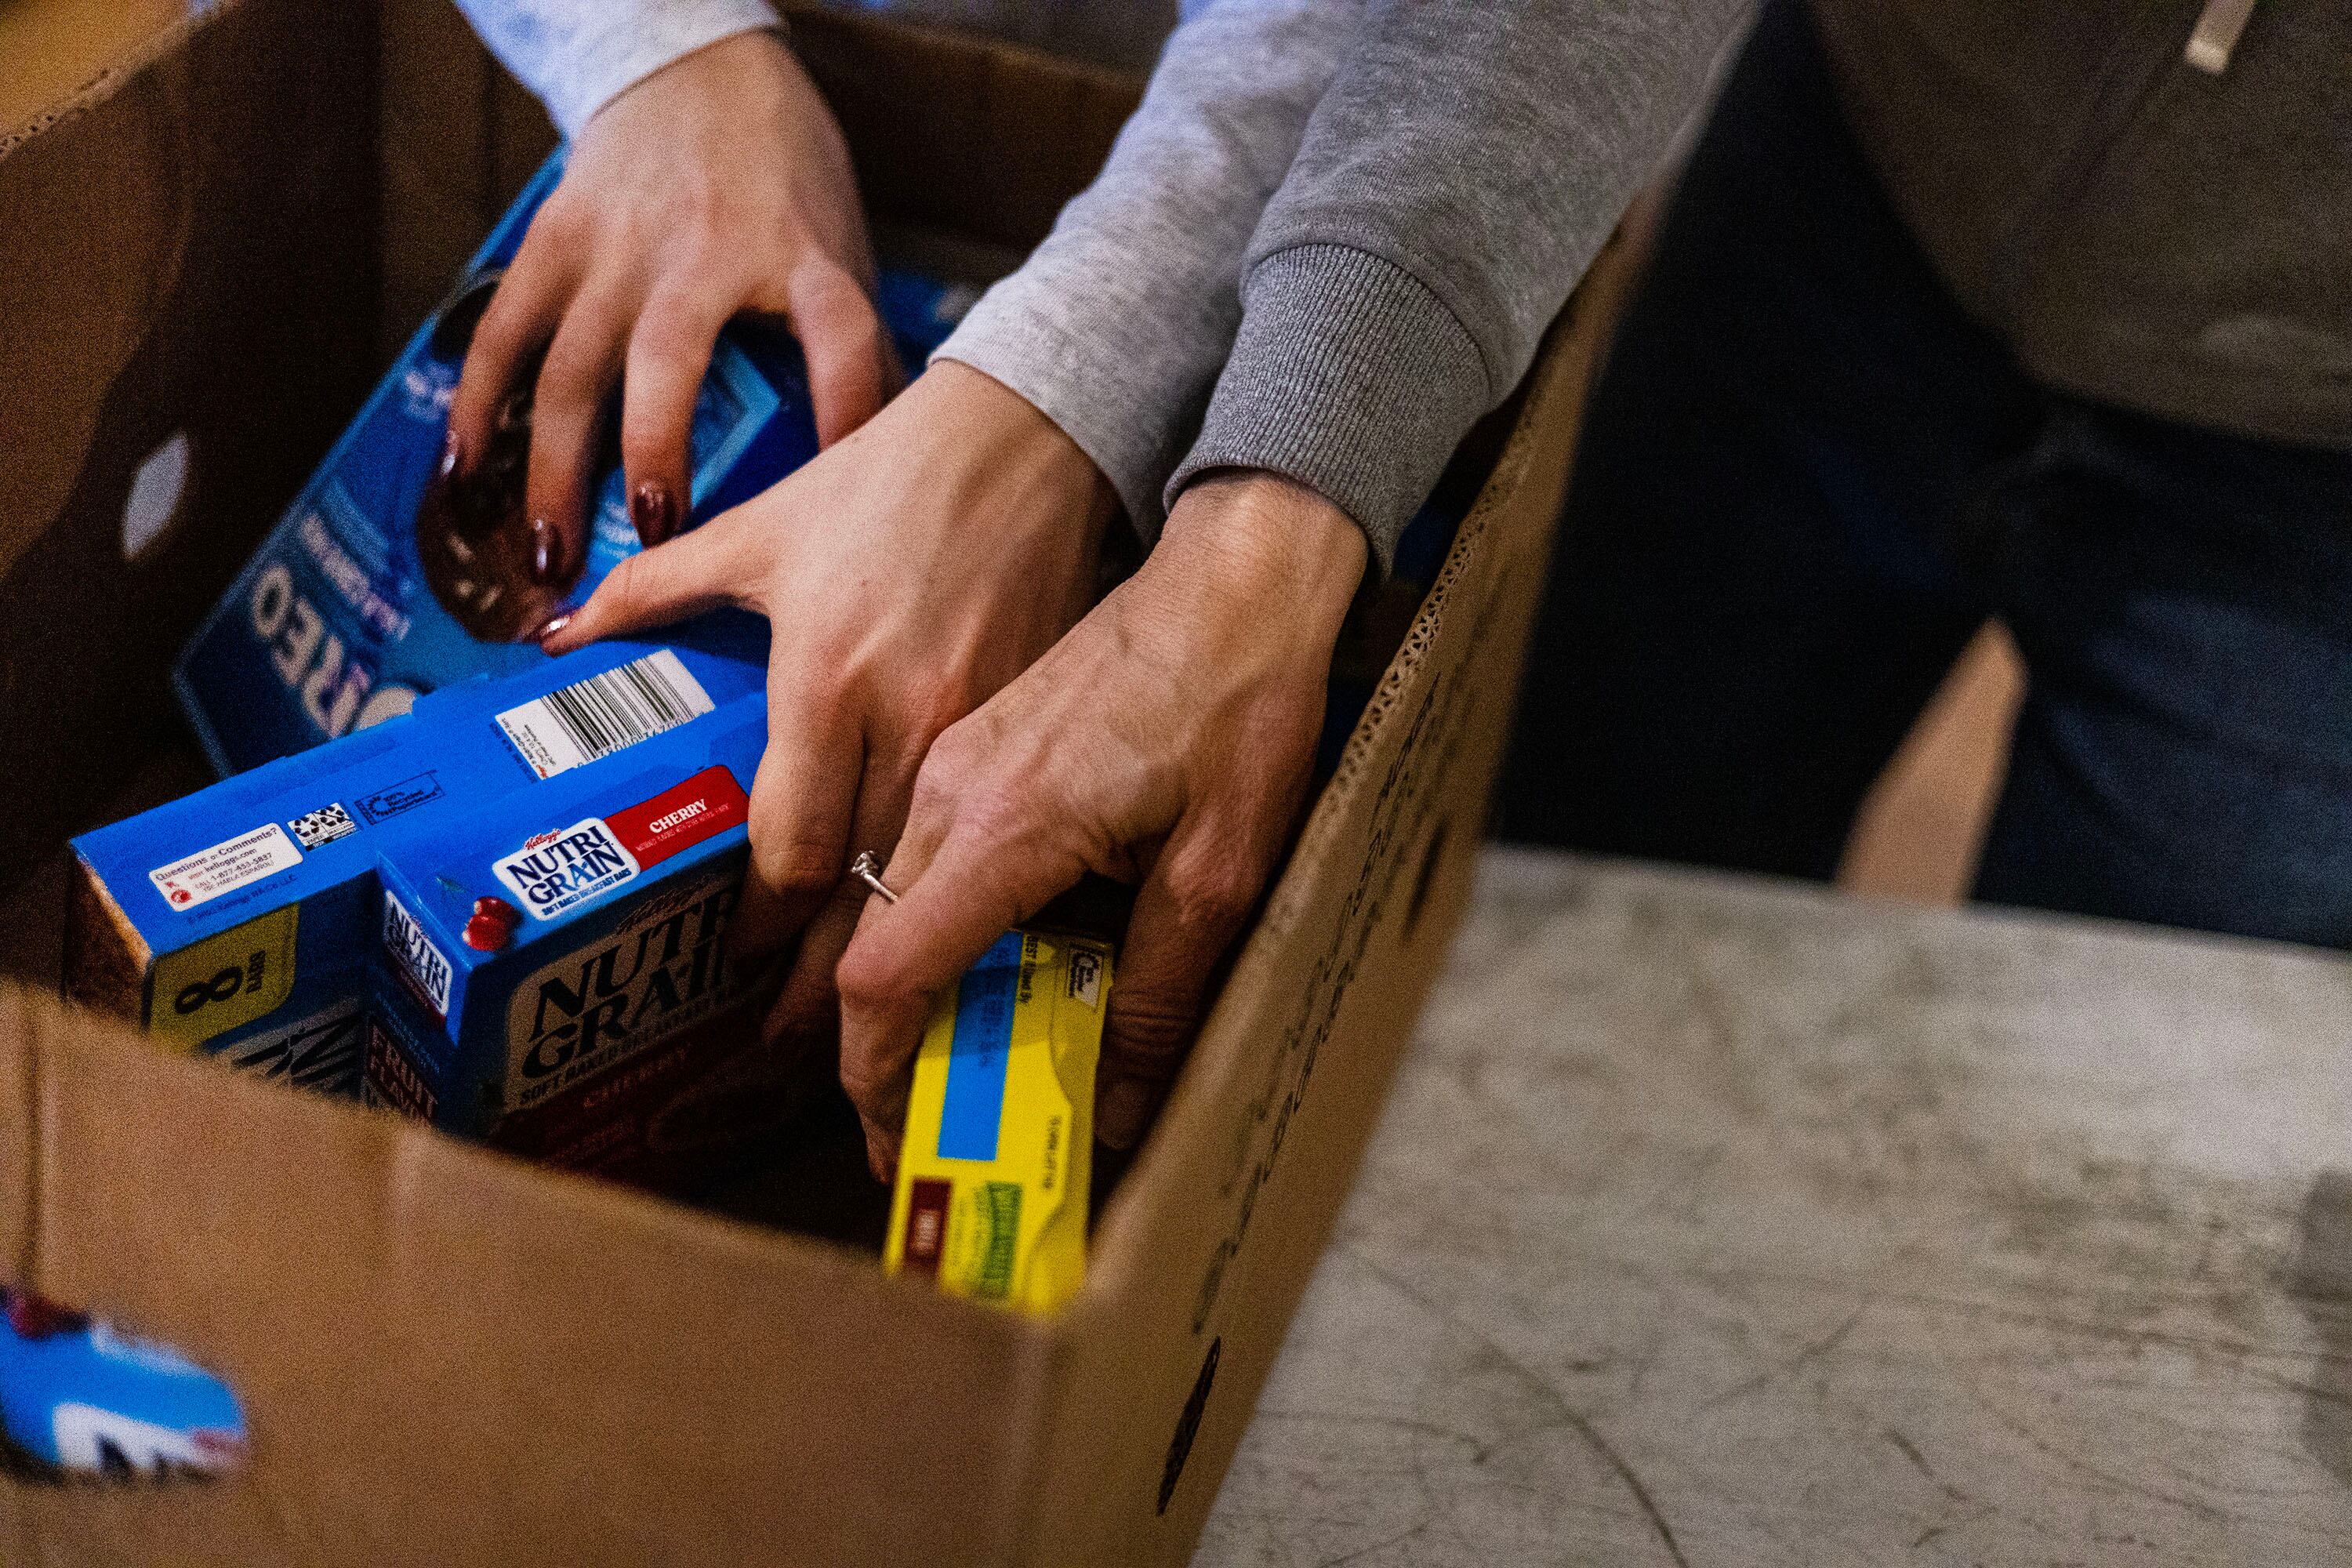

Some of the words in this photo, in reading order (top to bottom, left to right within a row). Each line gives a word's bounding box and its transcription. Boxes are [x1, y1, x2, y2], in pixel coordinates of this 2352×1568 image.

[524, 829, 561, 851] Kellogg's
[648, 798, 707, 833] CHERRY
[155, 857, 208, 881] Questions
[218, 827, 278, 855] Comments?
[205, 848, 257, 873] kelloggs.com
[506, 826, 608, 889] NUTRI
[528, 841, 626, 905] GRAIN
[542, 903, 561, 916] SOFT
[558, 894, 579, 909] BAKED
[579, 876, 615, 900] BREAKFAST
[614, 868, 632, 882] BARS
[388, 925, 446, 1000] GRAIN
[390, 904, 447, 980] NUTRI
[528, 886, 741, 1042] NUTR
[1025, 935, 1038, 960] BEST
[175, 967, 242, 1014] 8
[246, 950, 266, 993] BARS
[370, 1055, 424, 1119] FLAVO
[372, 1025, 438, 1117] FRUIT
[521, 1074, 561, 1105] SOFT
